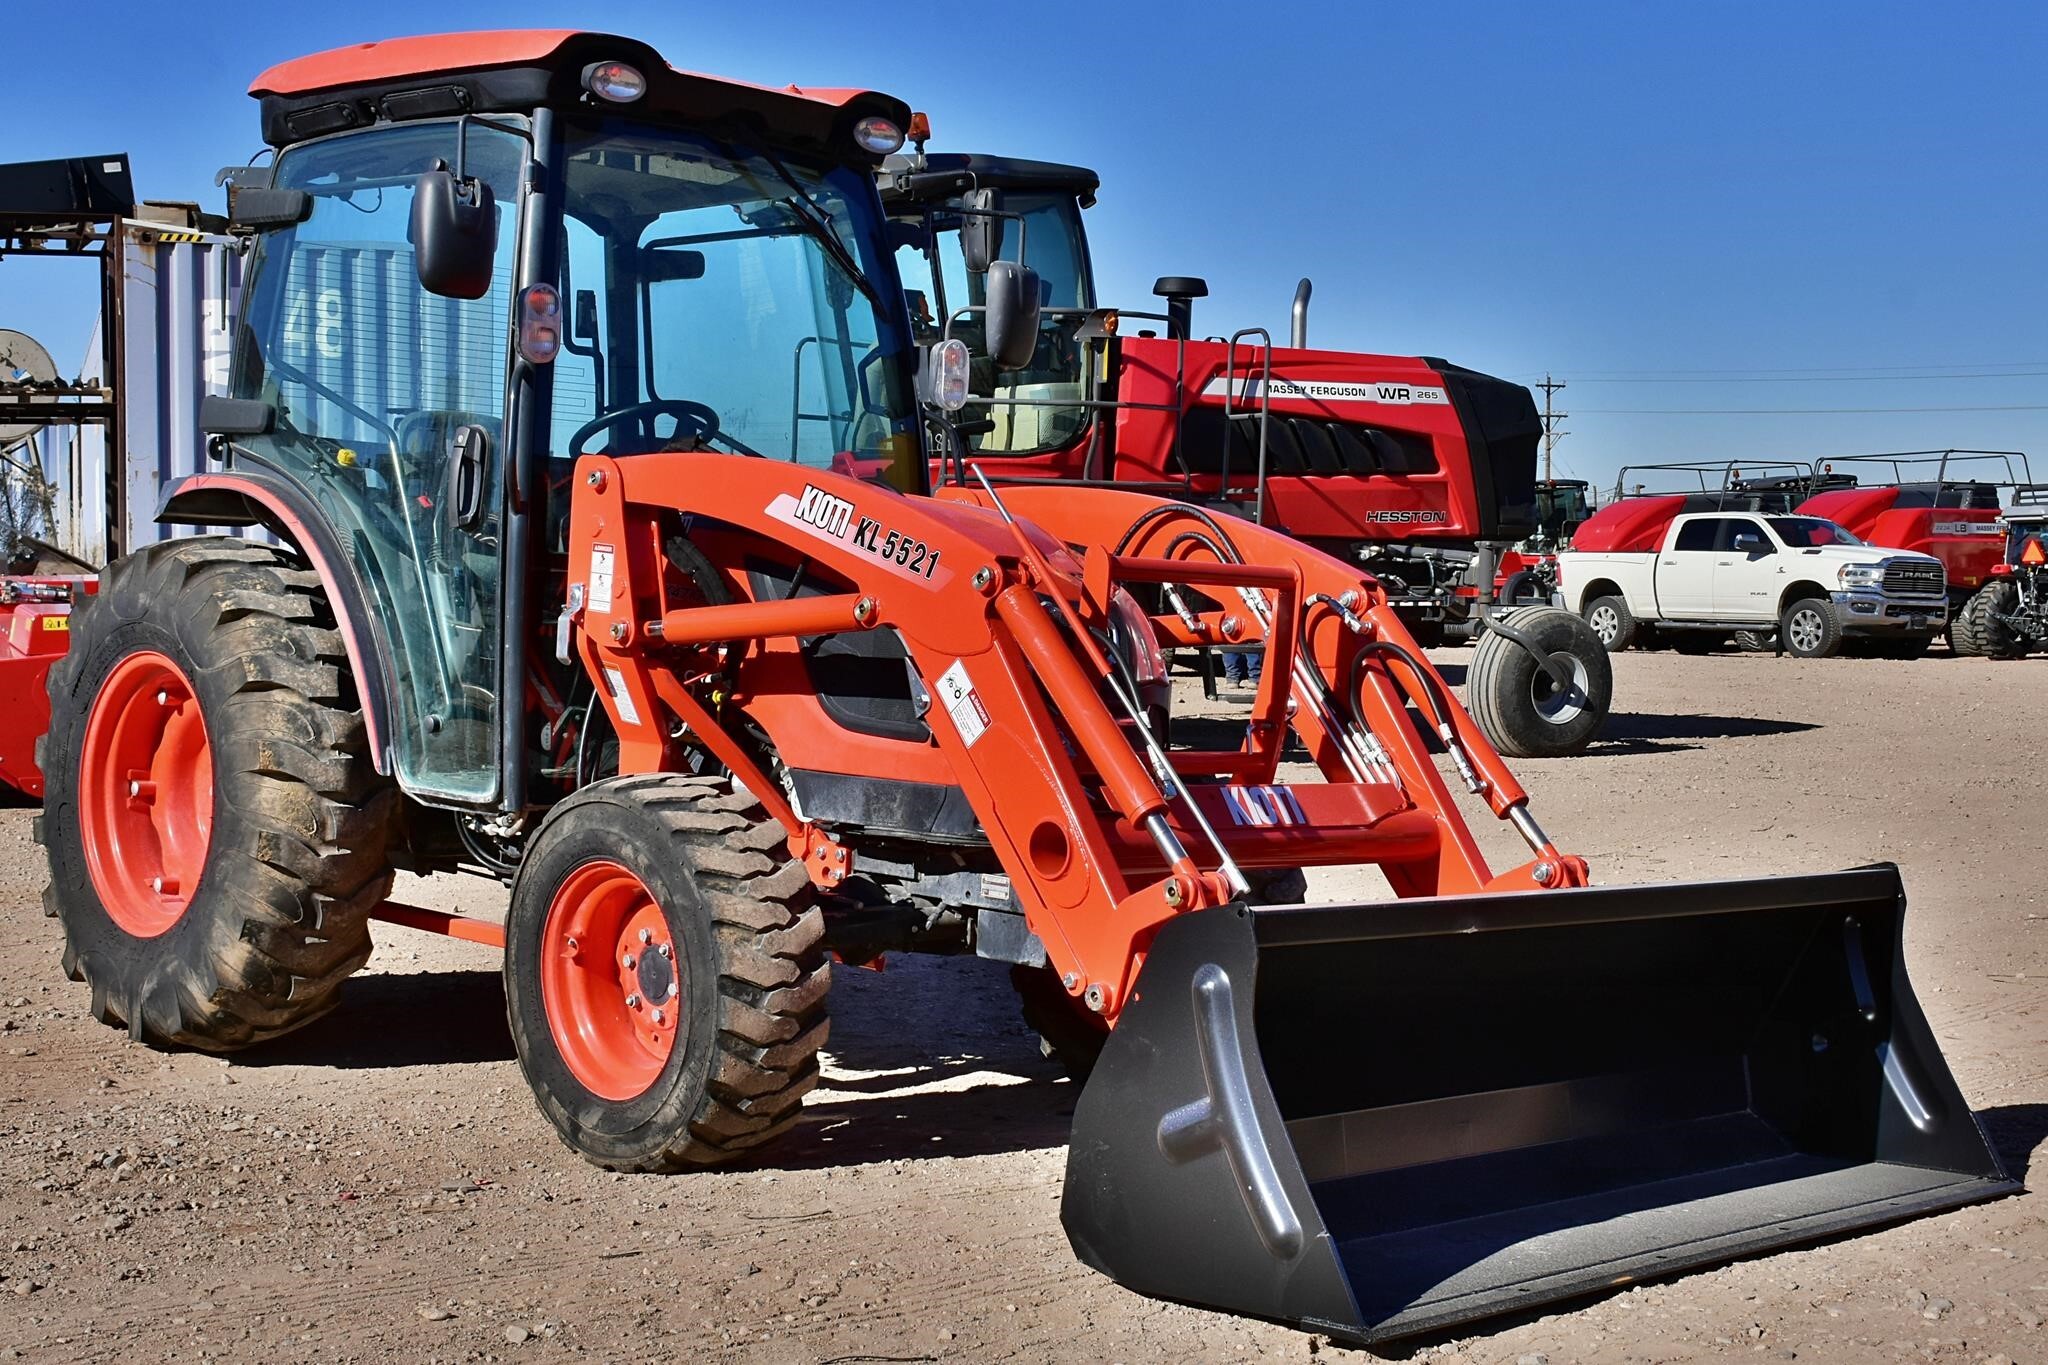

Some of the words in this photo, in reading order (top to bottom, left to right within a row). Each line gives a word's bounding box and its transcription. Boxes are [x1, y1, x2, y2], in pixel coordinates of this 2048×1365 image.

[1310, 386, 1366, 397] FERGUSON
[1376, 386, 1411, 400] WR
[1417, 391, 1439, 399] 265
[1365, 510, 1447, 523] HESSTON
[794, 483, 856, 539] KIOTI
[852, 515, 882, 556] KL
[881, 529, 941, 581] 5521
[1954, 523, 1967, 532] LB
[973, 699, 989, 724] DANGER
[1220, 785, 1306, 826] KIOTI
